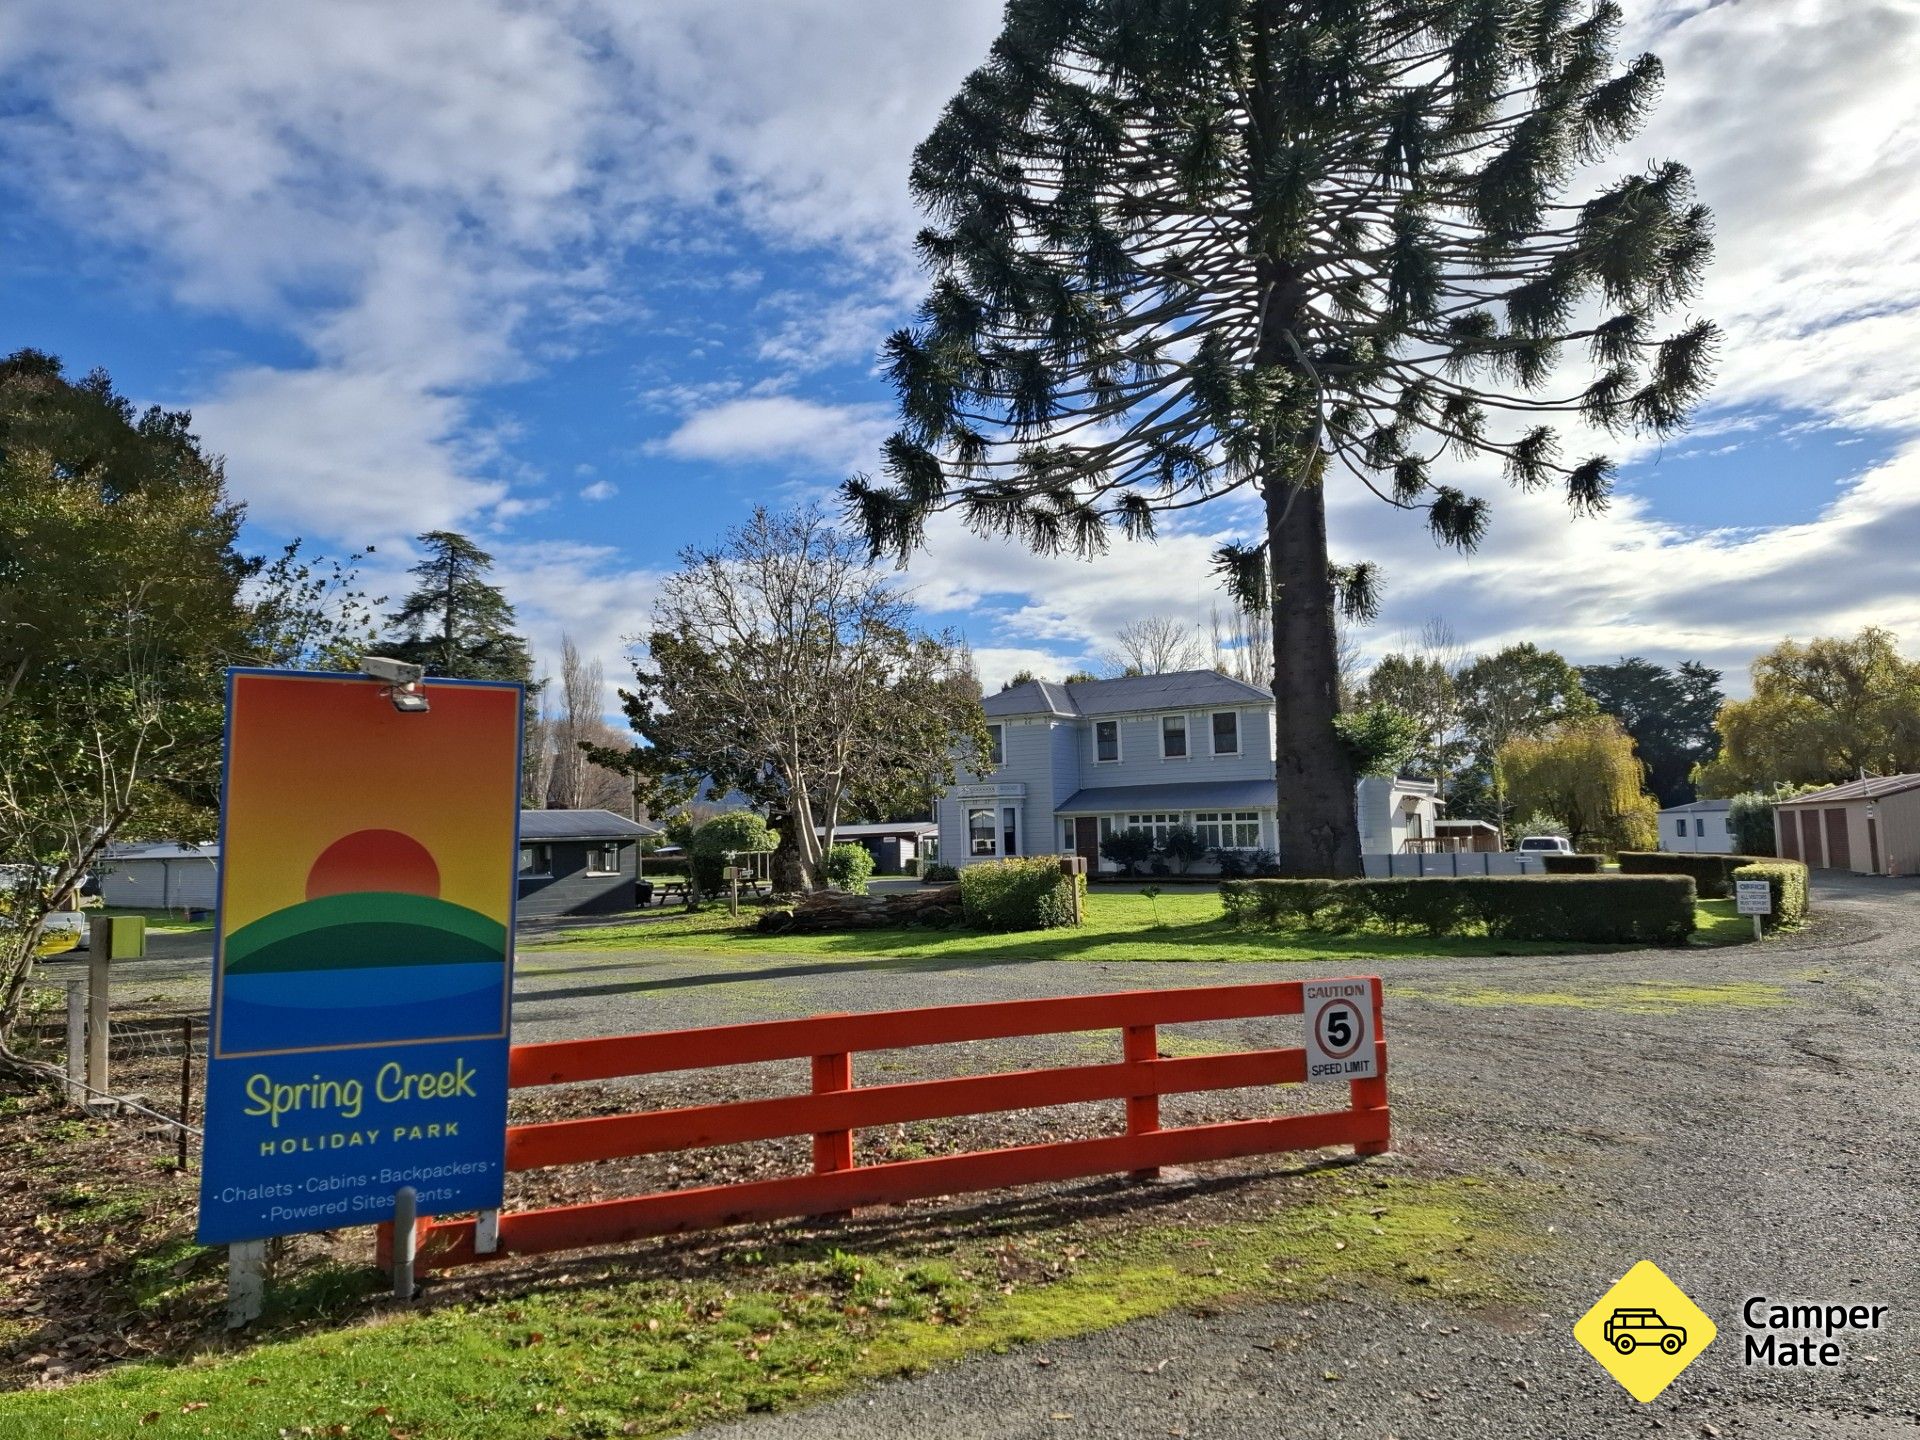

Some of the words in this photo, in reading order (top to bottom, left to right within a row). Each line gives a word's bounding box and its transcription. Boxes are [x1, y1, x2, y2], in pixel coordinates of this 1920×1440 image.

[1307, 985, 1365, 999] CAUTION
[1327, 1011, 1351, 1047] 5
[1311, 1063, 1342, 1076] SPEED
[1344, 1060, 1370, 1073] LIMIT
[243, 1073, 363, 1127] Spring
[376, 1058, 477, 1104] Creek
[260, 1130, 380, 1156] HOLIDAY
[393, 1122, 459, 1142] PARK
[221, 1182, 293, 1204] Chalets
[305, 1172, 367, 1194] Cabins
[379, 1159, 487, 1184] Backpackers
[270, 1200, 348, 1222] Powered
[352, 1195, 396, 1212] Sites
[414, 1187, 453, 1203] ents
